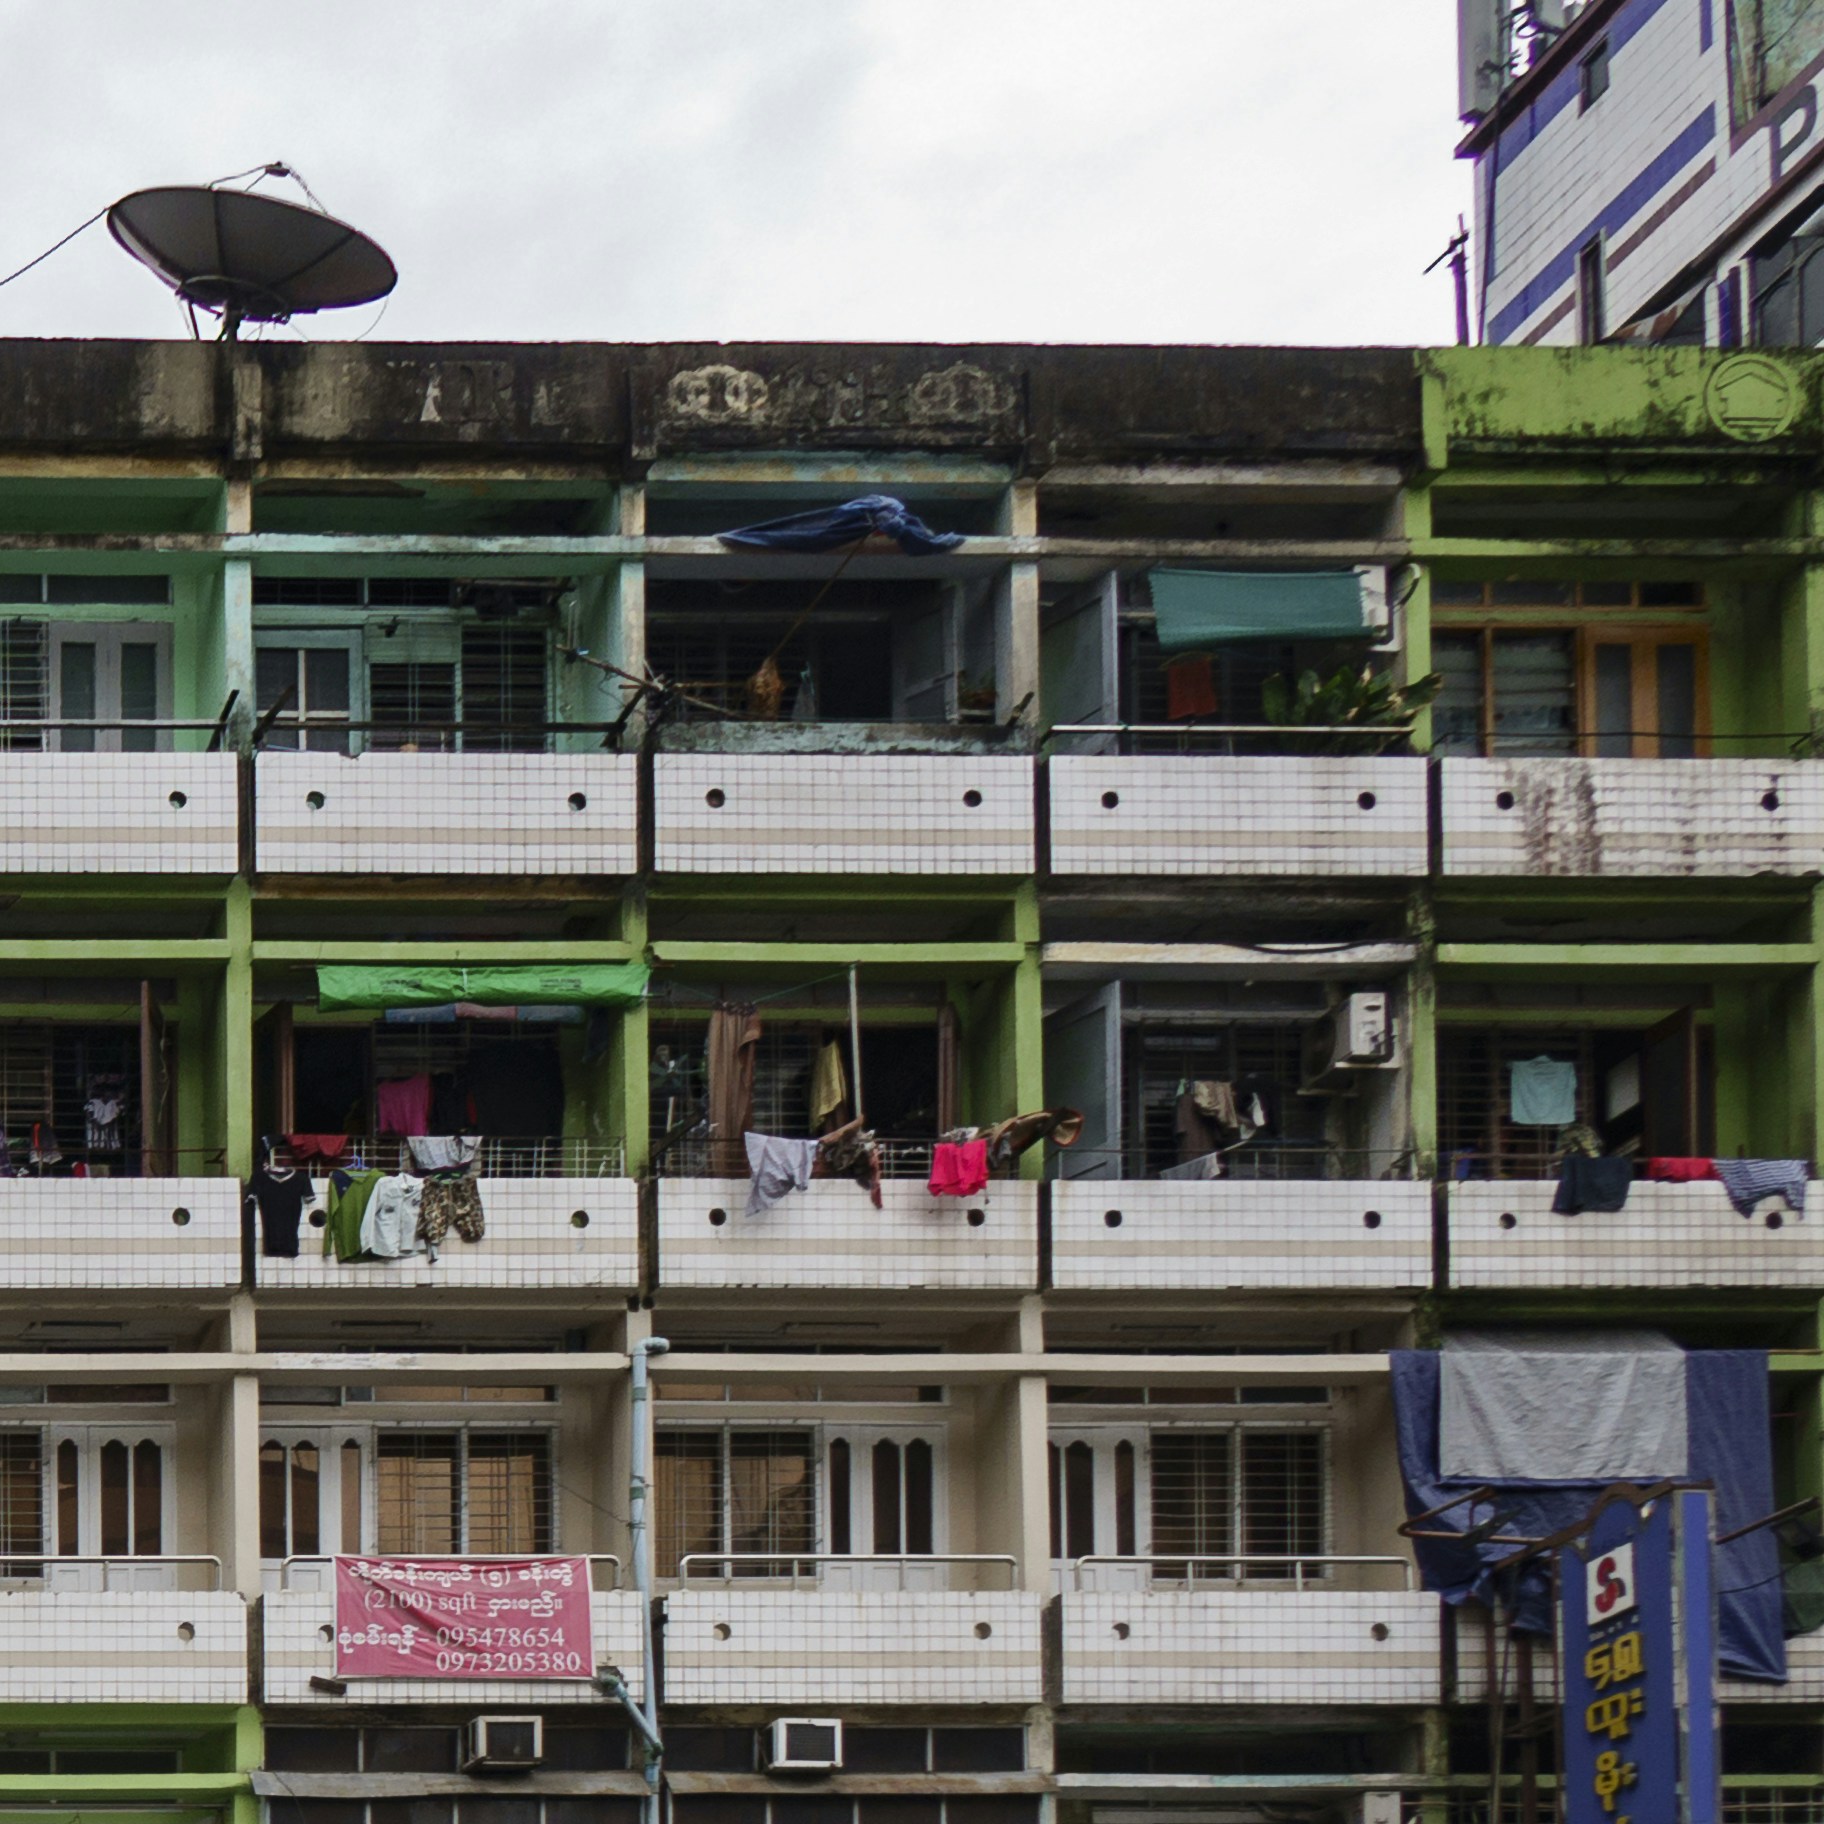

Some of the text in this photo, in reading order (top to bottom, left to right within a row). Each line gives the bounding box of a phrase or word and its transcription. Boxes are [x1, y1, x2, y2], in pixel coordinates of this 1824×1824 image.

[364, 1591, 432, 1613] (2100)
[438, 1591, 478, 1616] sqft
[436, 1626, 565, 1648] 095478654
[436, 1651, 581, 1673] 0973205380
